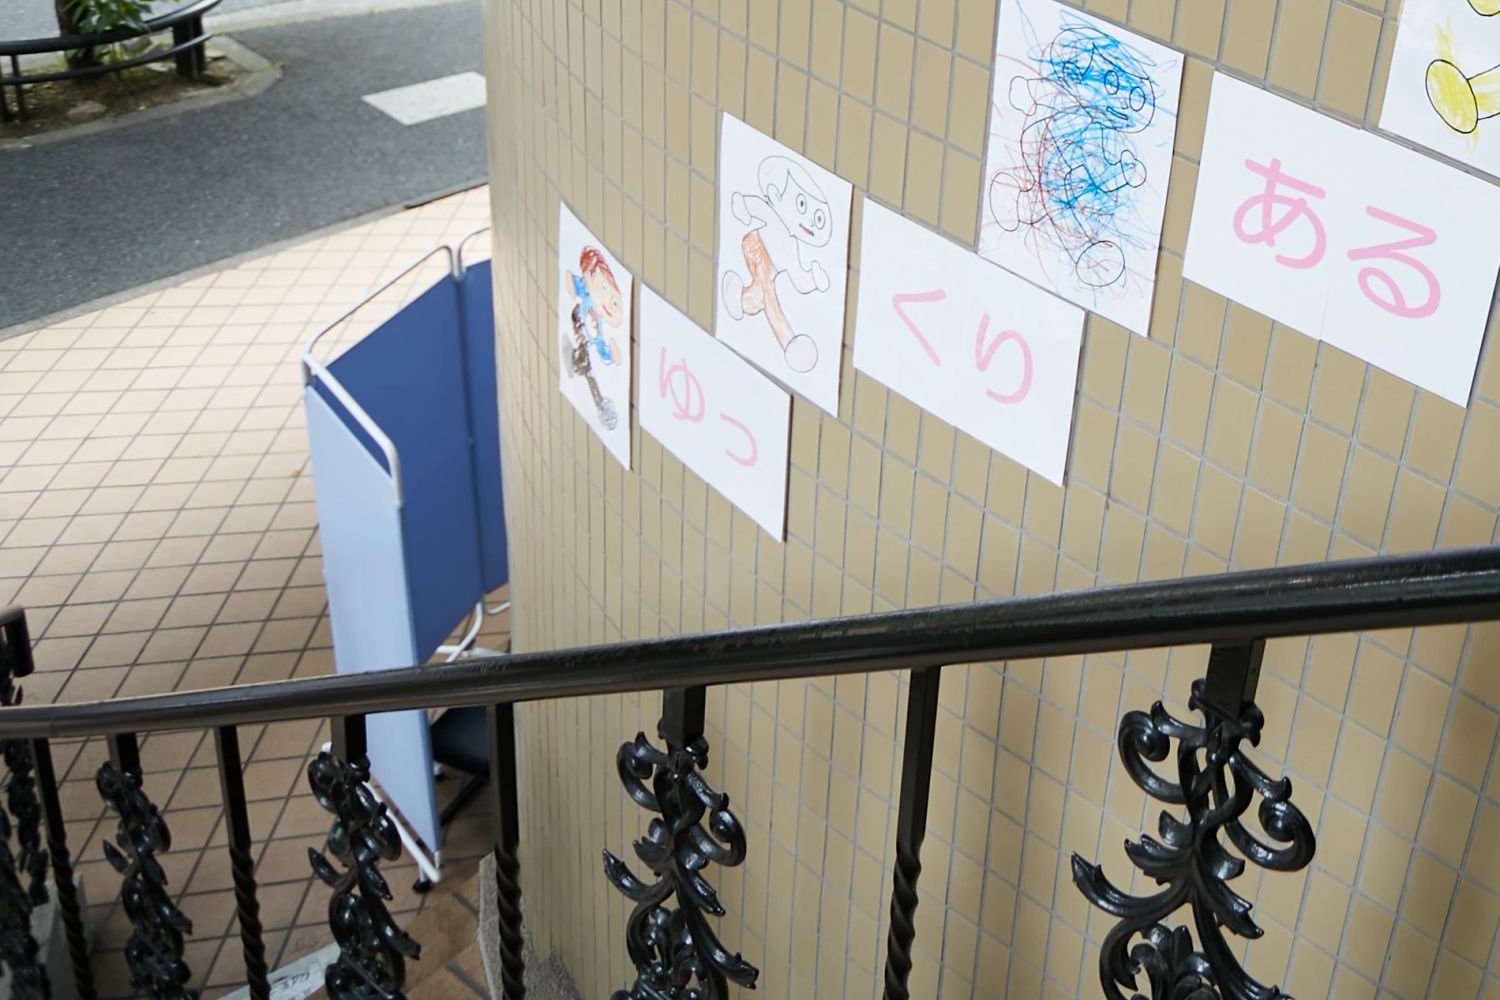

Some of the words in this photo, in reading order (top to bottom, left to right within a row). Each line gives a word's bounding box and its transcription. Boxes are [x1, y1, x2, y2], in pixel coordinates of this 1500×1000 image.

[1232, 157, 1441, 319] ある
[659, 346, 759, 467] ゆっ
[891, 289, 1033, 404] くり
